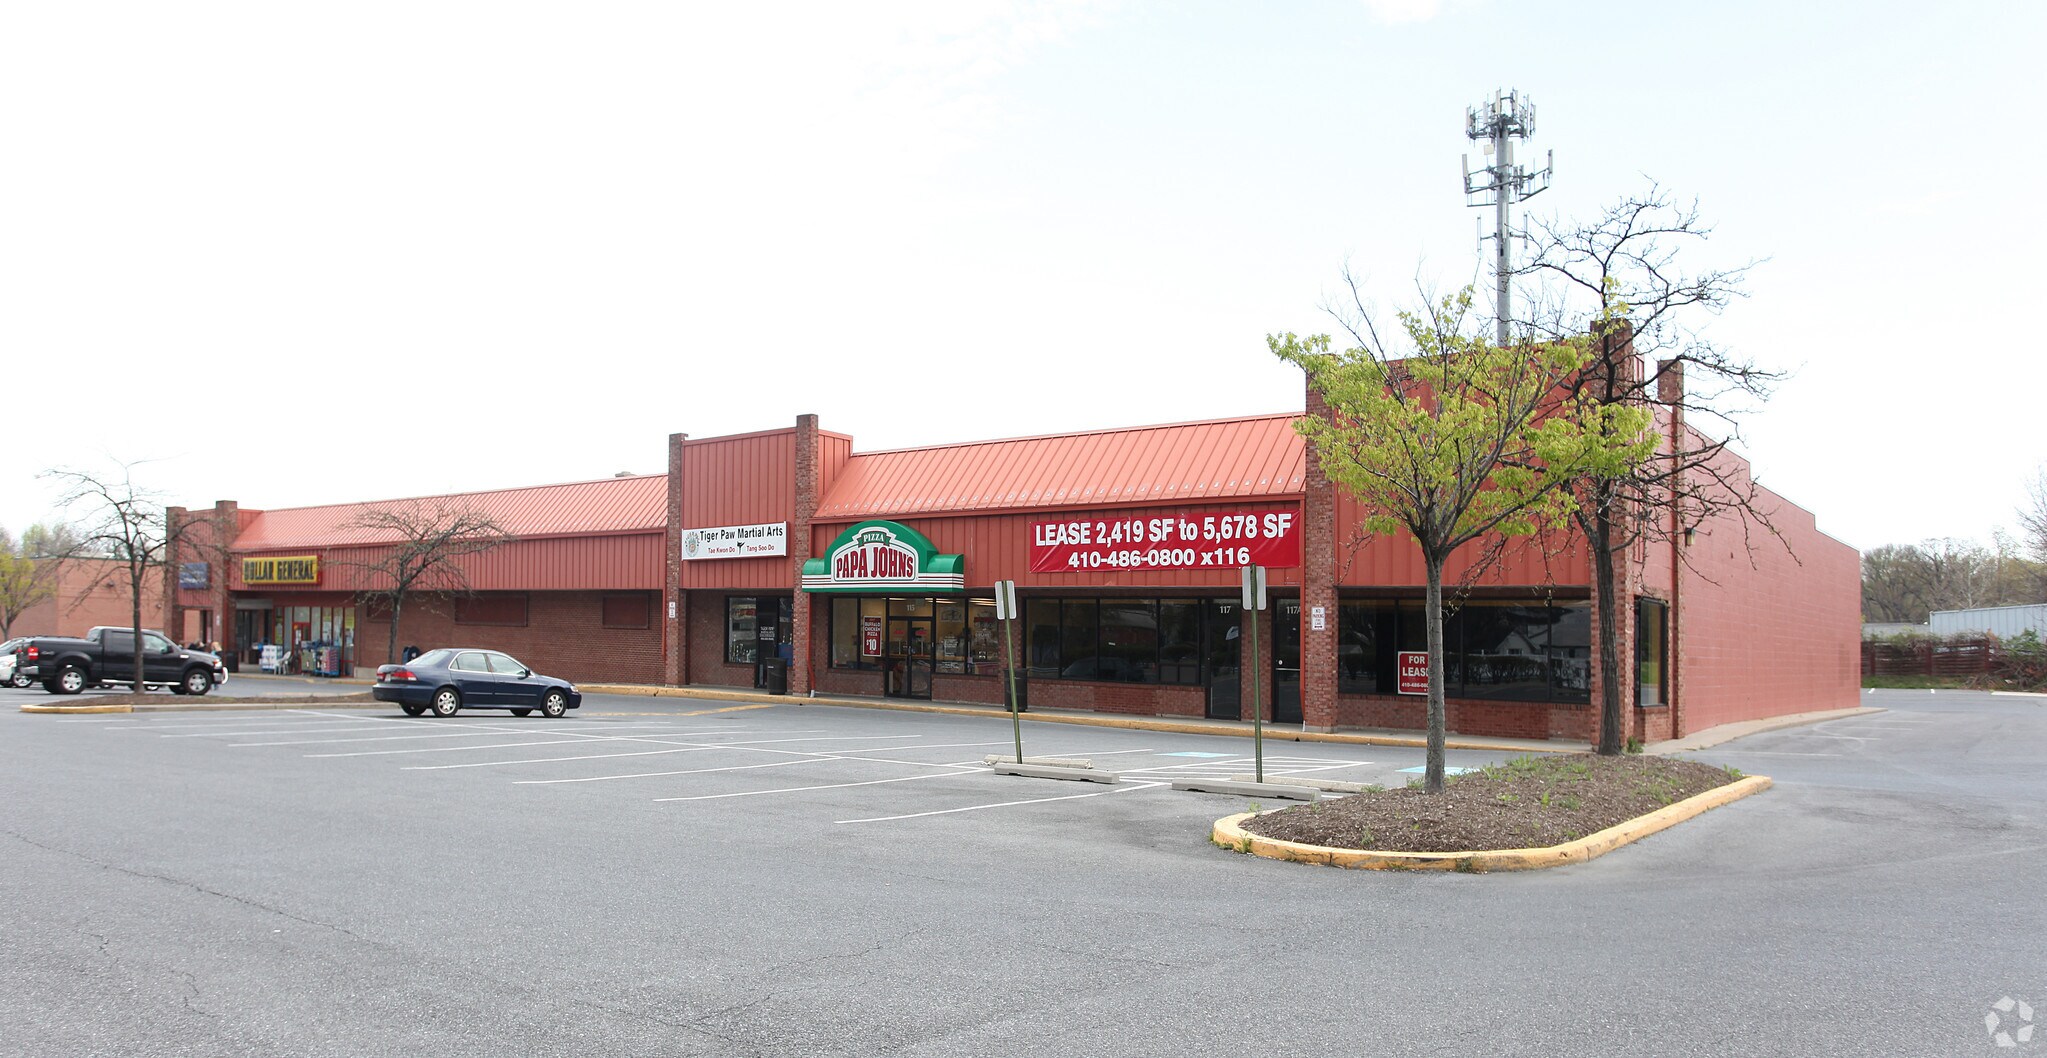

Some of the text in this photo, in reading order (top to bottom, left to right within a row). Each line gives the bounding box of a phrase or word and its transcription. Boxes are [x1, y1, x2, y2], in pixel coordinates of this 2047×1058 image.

[700, 530, 718, 543] Tiger
[720, 529, 735, 540] Paw
[737, 526, 764, 539] Martial
[767, 526, 783, 537] Arts
[863, 533, 884, 542] PIZZA
[1035, 513, 1292, 547] LEASE 2,419 SF to 5,678 SF
[836, 547, 913, 578] PAPA JOHN'S
[1068, 546, 1250, 568] 410-486-0800 x116
[244, 559, 314, 581] DOLLAR GENERAL
[1220, 605, 1231, 614] 117
[866, 639, 877, 650] $10
[1408, 655, 1425, 664] FOR
